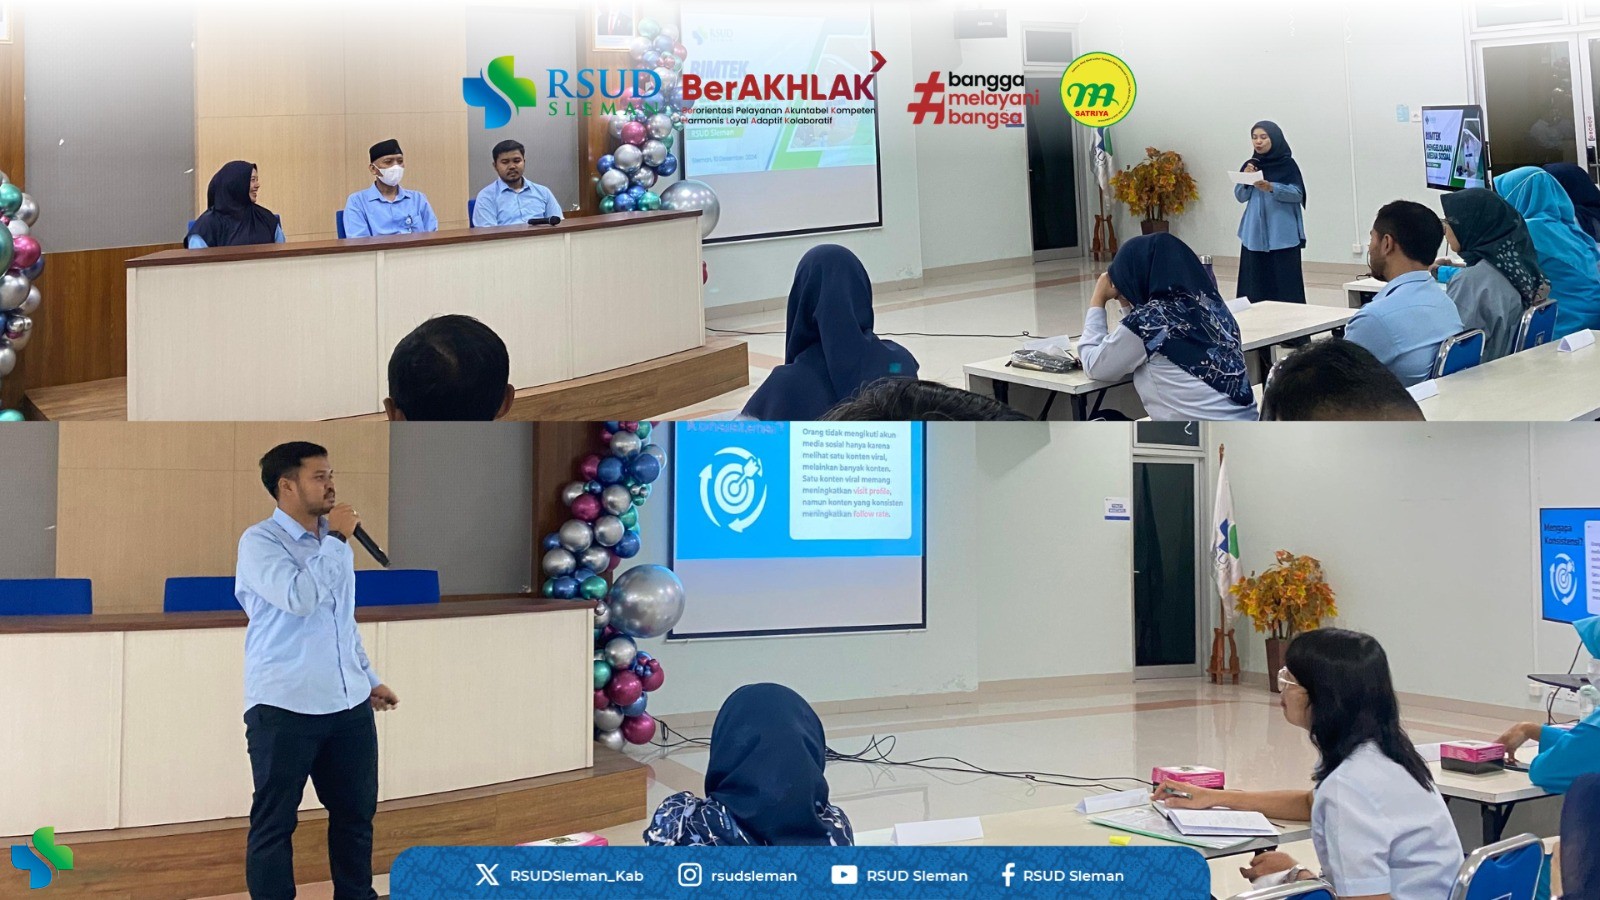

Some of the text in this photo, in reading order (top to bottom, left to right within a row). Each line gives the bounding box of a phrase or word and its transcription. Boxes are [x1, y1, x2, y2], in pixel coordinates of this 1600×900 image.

[802, 428, 824, 437] Orang
[844, 430, 878, 438] mengikuti
[846, 441, 866, 450] hanya
[871, 453, 887, 461] viral,
[840, 464, 865, 472] banyak
[802, 487, 852, 495] meningkatkan
[802, 510, 852, 518] meningkatkan
